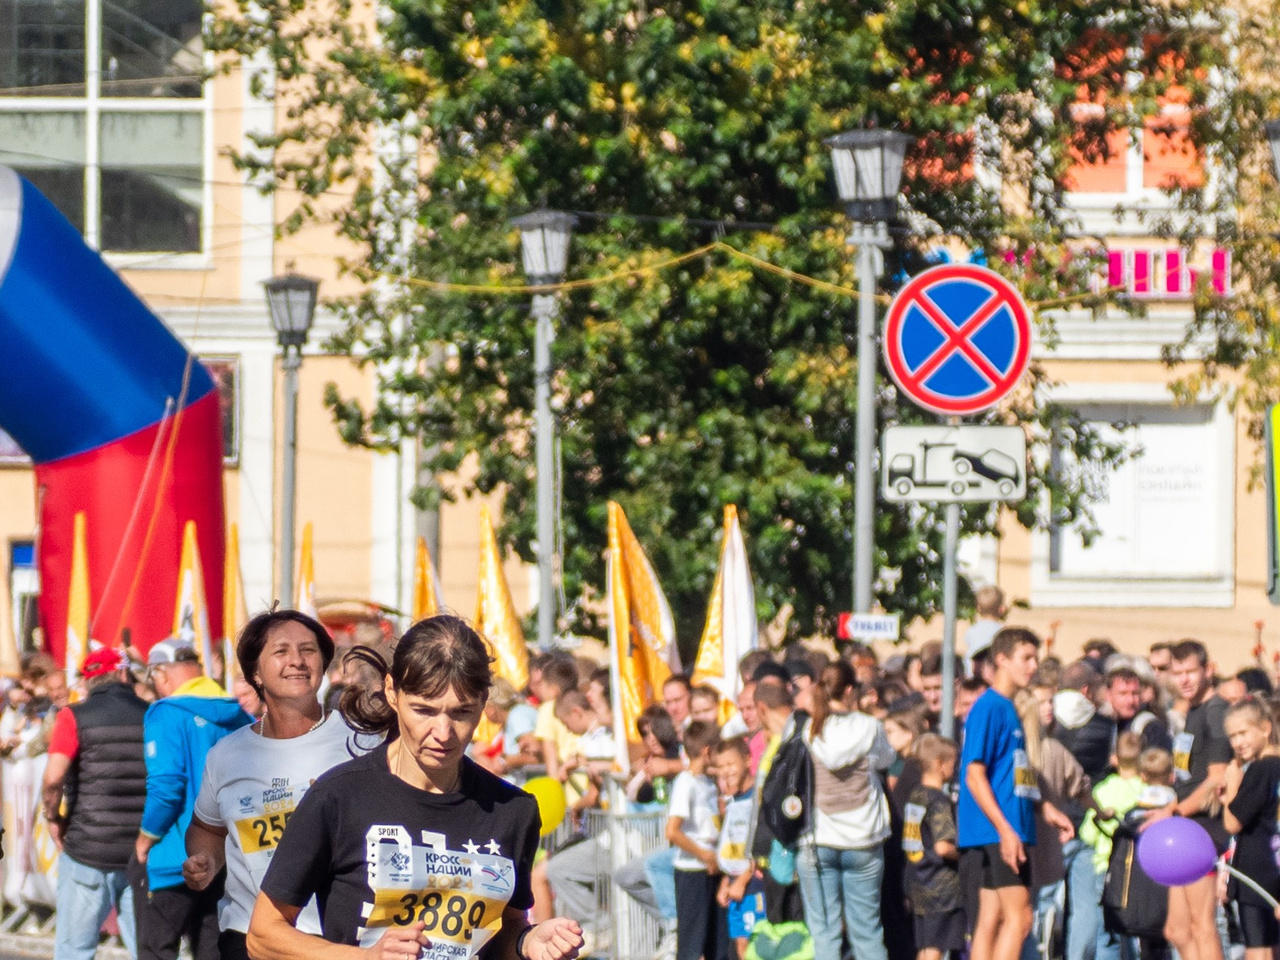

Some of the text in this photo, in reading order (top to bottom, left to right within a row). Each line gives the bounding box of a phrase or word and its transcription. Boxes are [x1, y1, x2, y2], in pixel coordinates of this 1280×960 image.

[378, 827, 399, 836] SPORT
[425, 852, 460, 865] КРОСС
[426, 863, 472, 877] НАЦИИ
[392, 892, 486, 940] 3889
